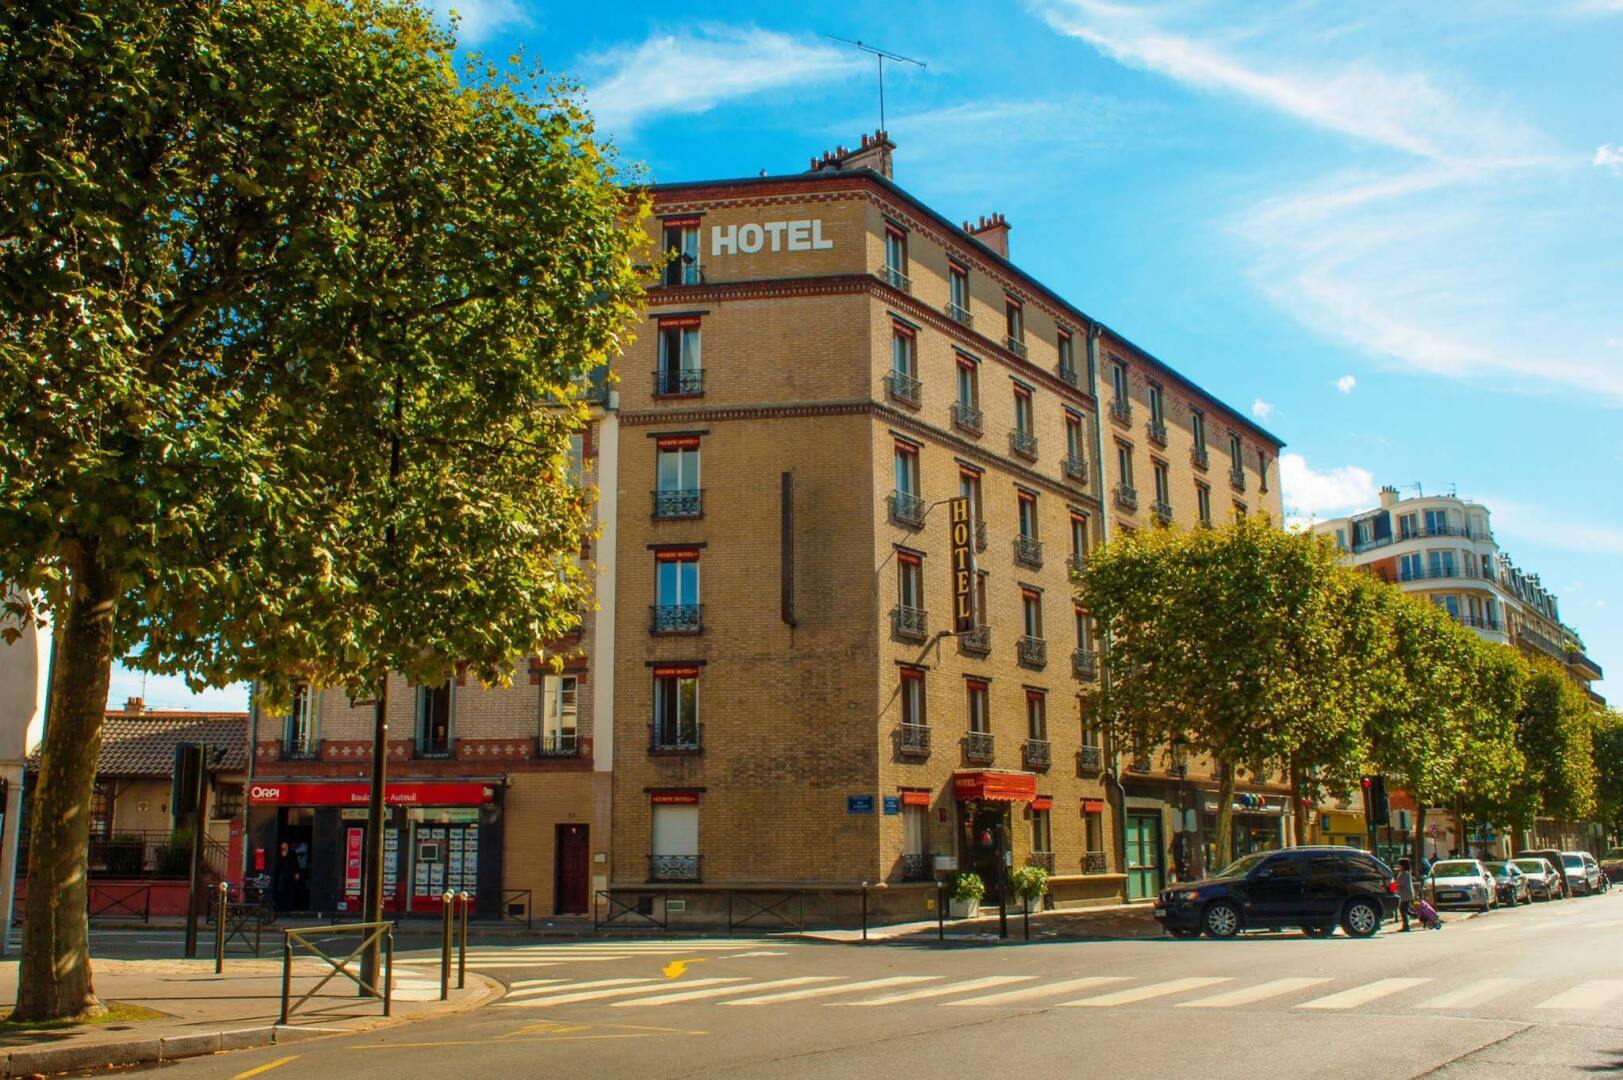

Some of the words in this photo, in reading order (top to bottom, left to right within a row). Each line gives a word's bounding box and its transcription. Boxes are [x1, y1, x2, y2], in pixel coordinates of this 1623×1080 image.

[711, 219, 834, 256] HOTEL
[952, 499, 970, 618] HOTEL
[251, 786, 280, 798] ORPI
[390, 793, 417, 801] Auteuil
